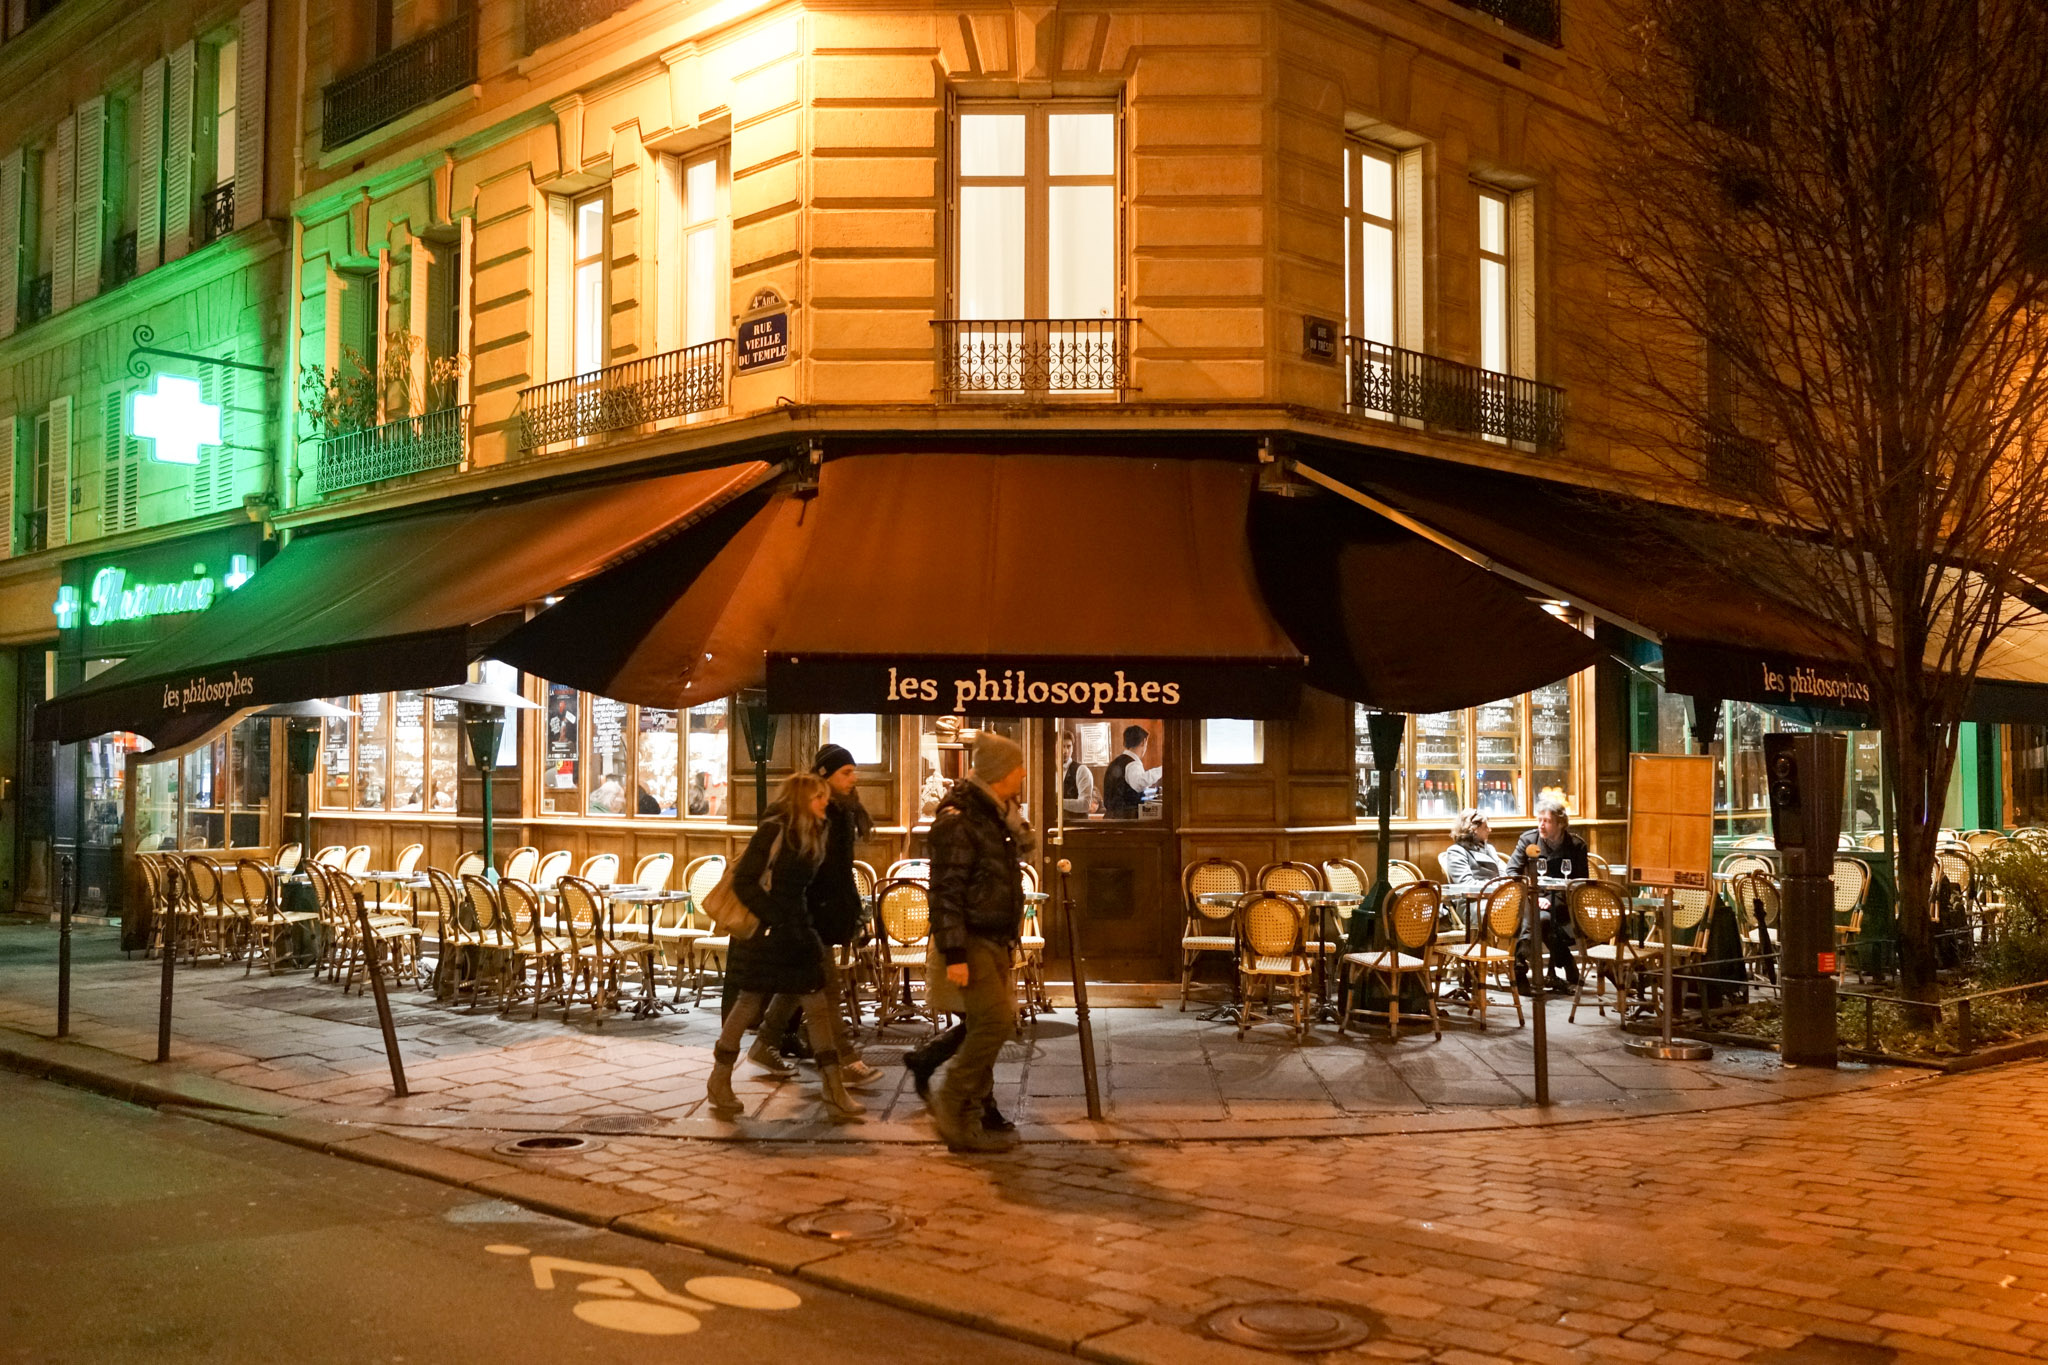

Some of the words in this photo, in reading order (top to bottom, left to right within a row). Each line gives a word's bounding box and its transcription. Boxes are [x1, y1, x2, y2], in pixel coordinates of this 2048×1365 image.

[746, 333, 780, 350] VIEILLE
[754, 321, 772, 335] RUE
[740, 354, 750, 366] DU
[753, 345, 787, 362] TEMPLE
[89, 563, 216, 626] Pharmacie
[163, 683, 180, 709] les
[182, 670, 254, 713] philosophes
[887, 667, 938, 700] les
[953, 668, 1180, 715] philosophes
[1761, 661, 1785, 692] les
[1789, 666, 1870, 707] philosophes
